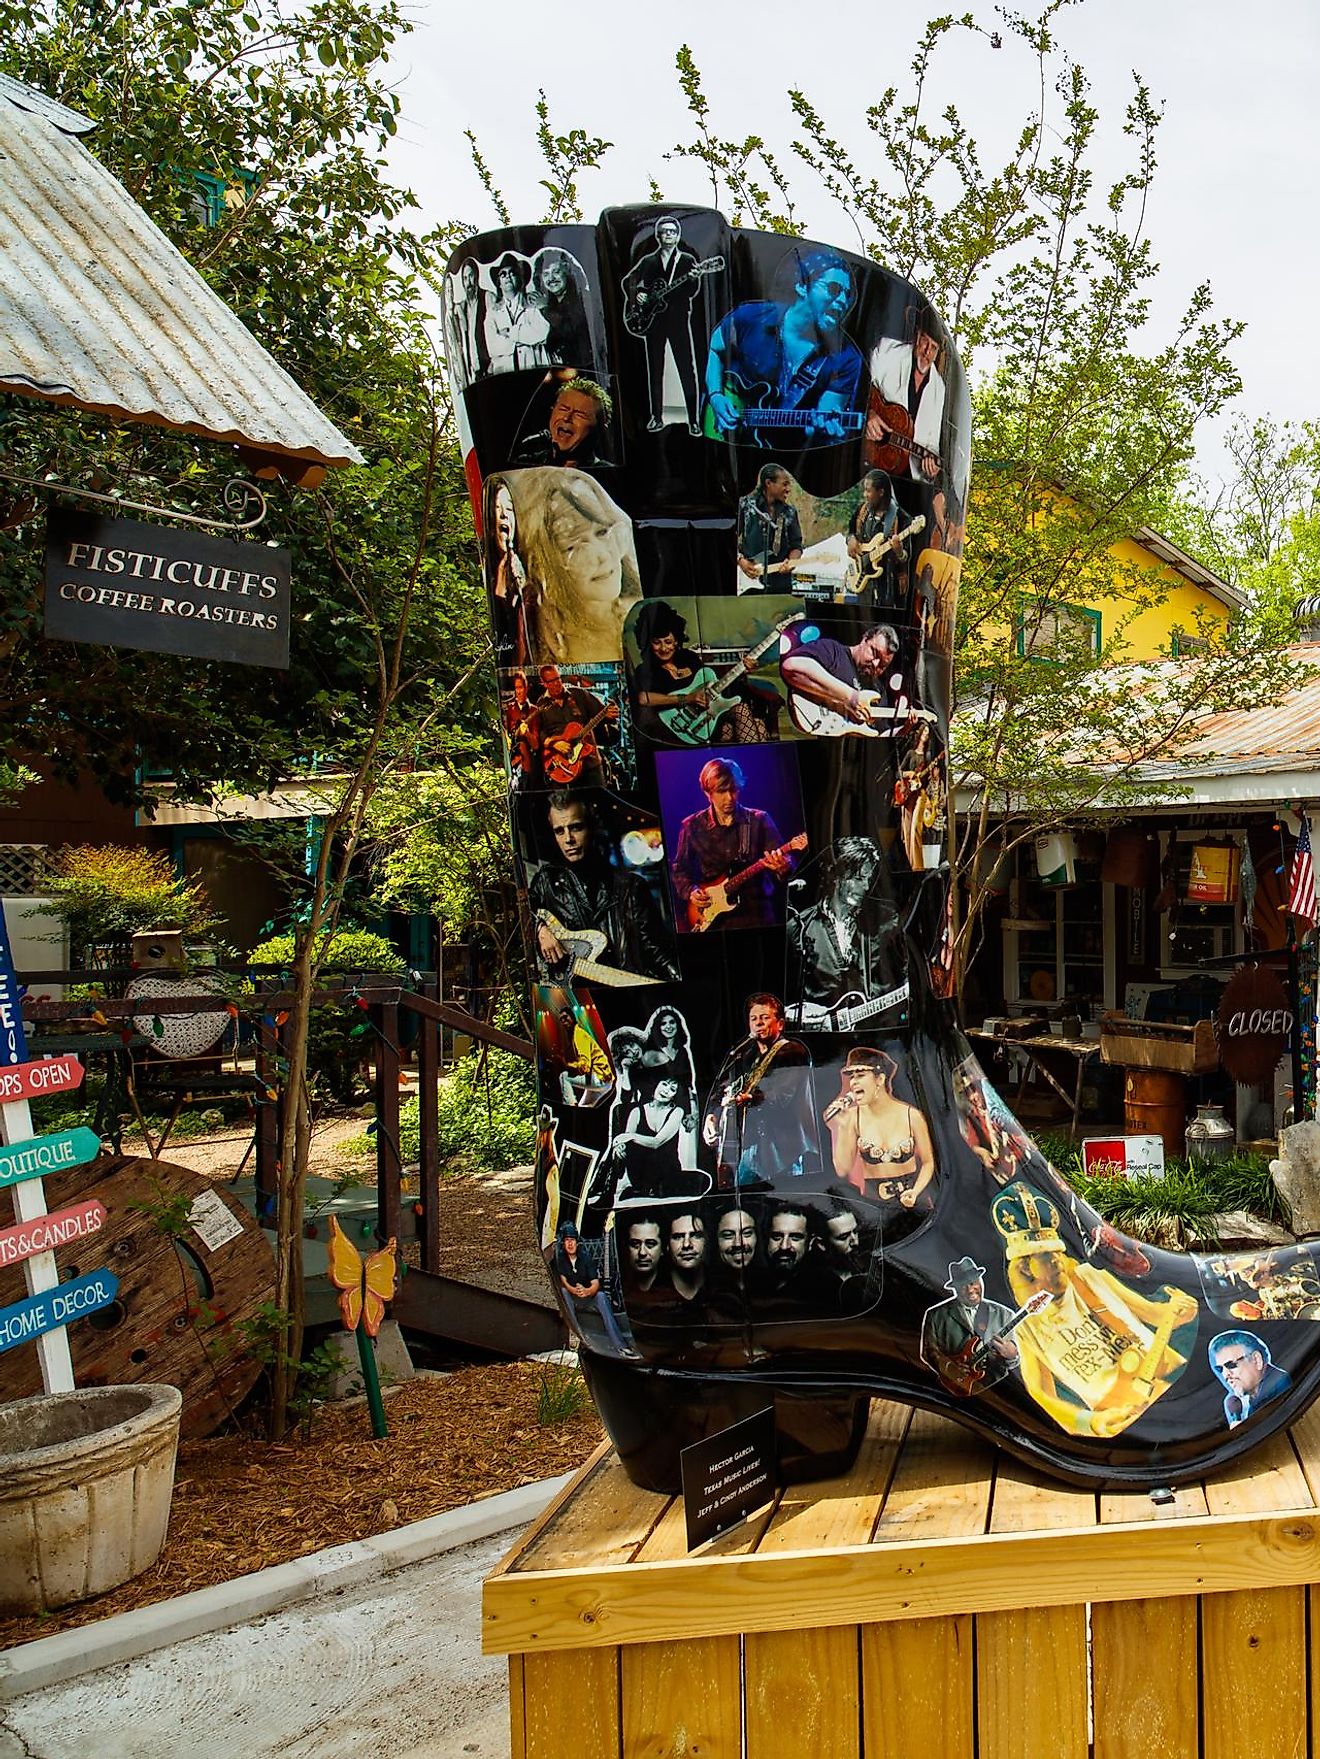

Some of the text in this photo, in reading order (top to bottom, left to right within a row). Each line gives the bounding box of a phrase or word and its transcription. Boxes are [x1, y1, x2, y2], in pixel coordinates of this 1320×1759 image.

[68, 543, 277, 599] FISTICUFFS
[60, 583, 278, 630] COFFEE ROASTERS
[1229, 1008, 1294, 1037] CLOSED
[30, 1062, 71, 1088] OPEN
[0, 1140, 76, 1178] OUTIQUE
[0, 1208, 101, 1263] TS&CANDLES
[0, 1282, 109, 1346] HOME DECOR
[1059, 1339, 1098, 1370] mess
[704, 1458, 761, 1496] TEXAS MUSIC LIVES!
[709, 1445, 755, 1474] HECTOR GARCIA
[697, 1504, 713, 1519] JEFF
[719, 1491, 738, 1507] CINDY
[738, 1473, 768, 1495] ANDERSON
